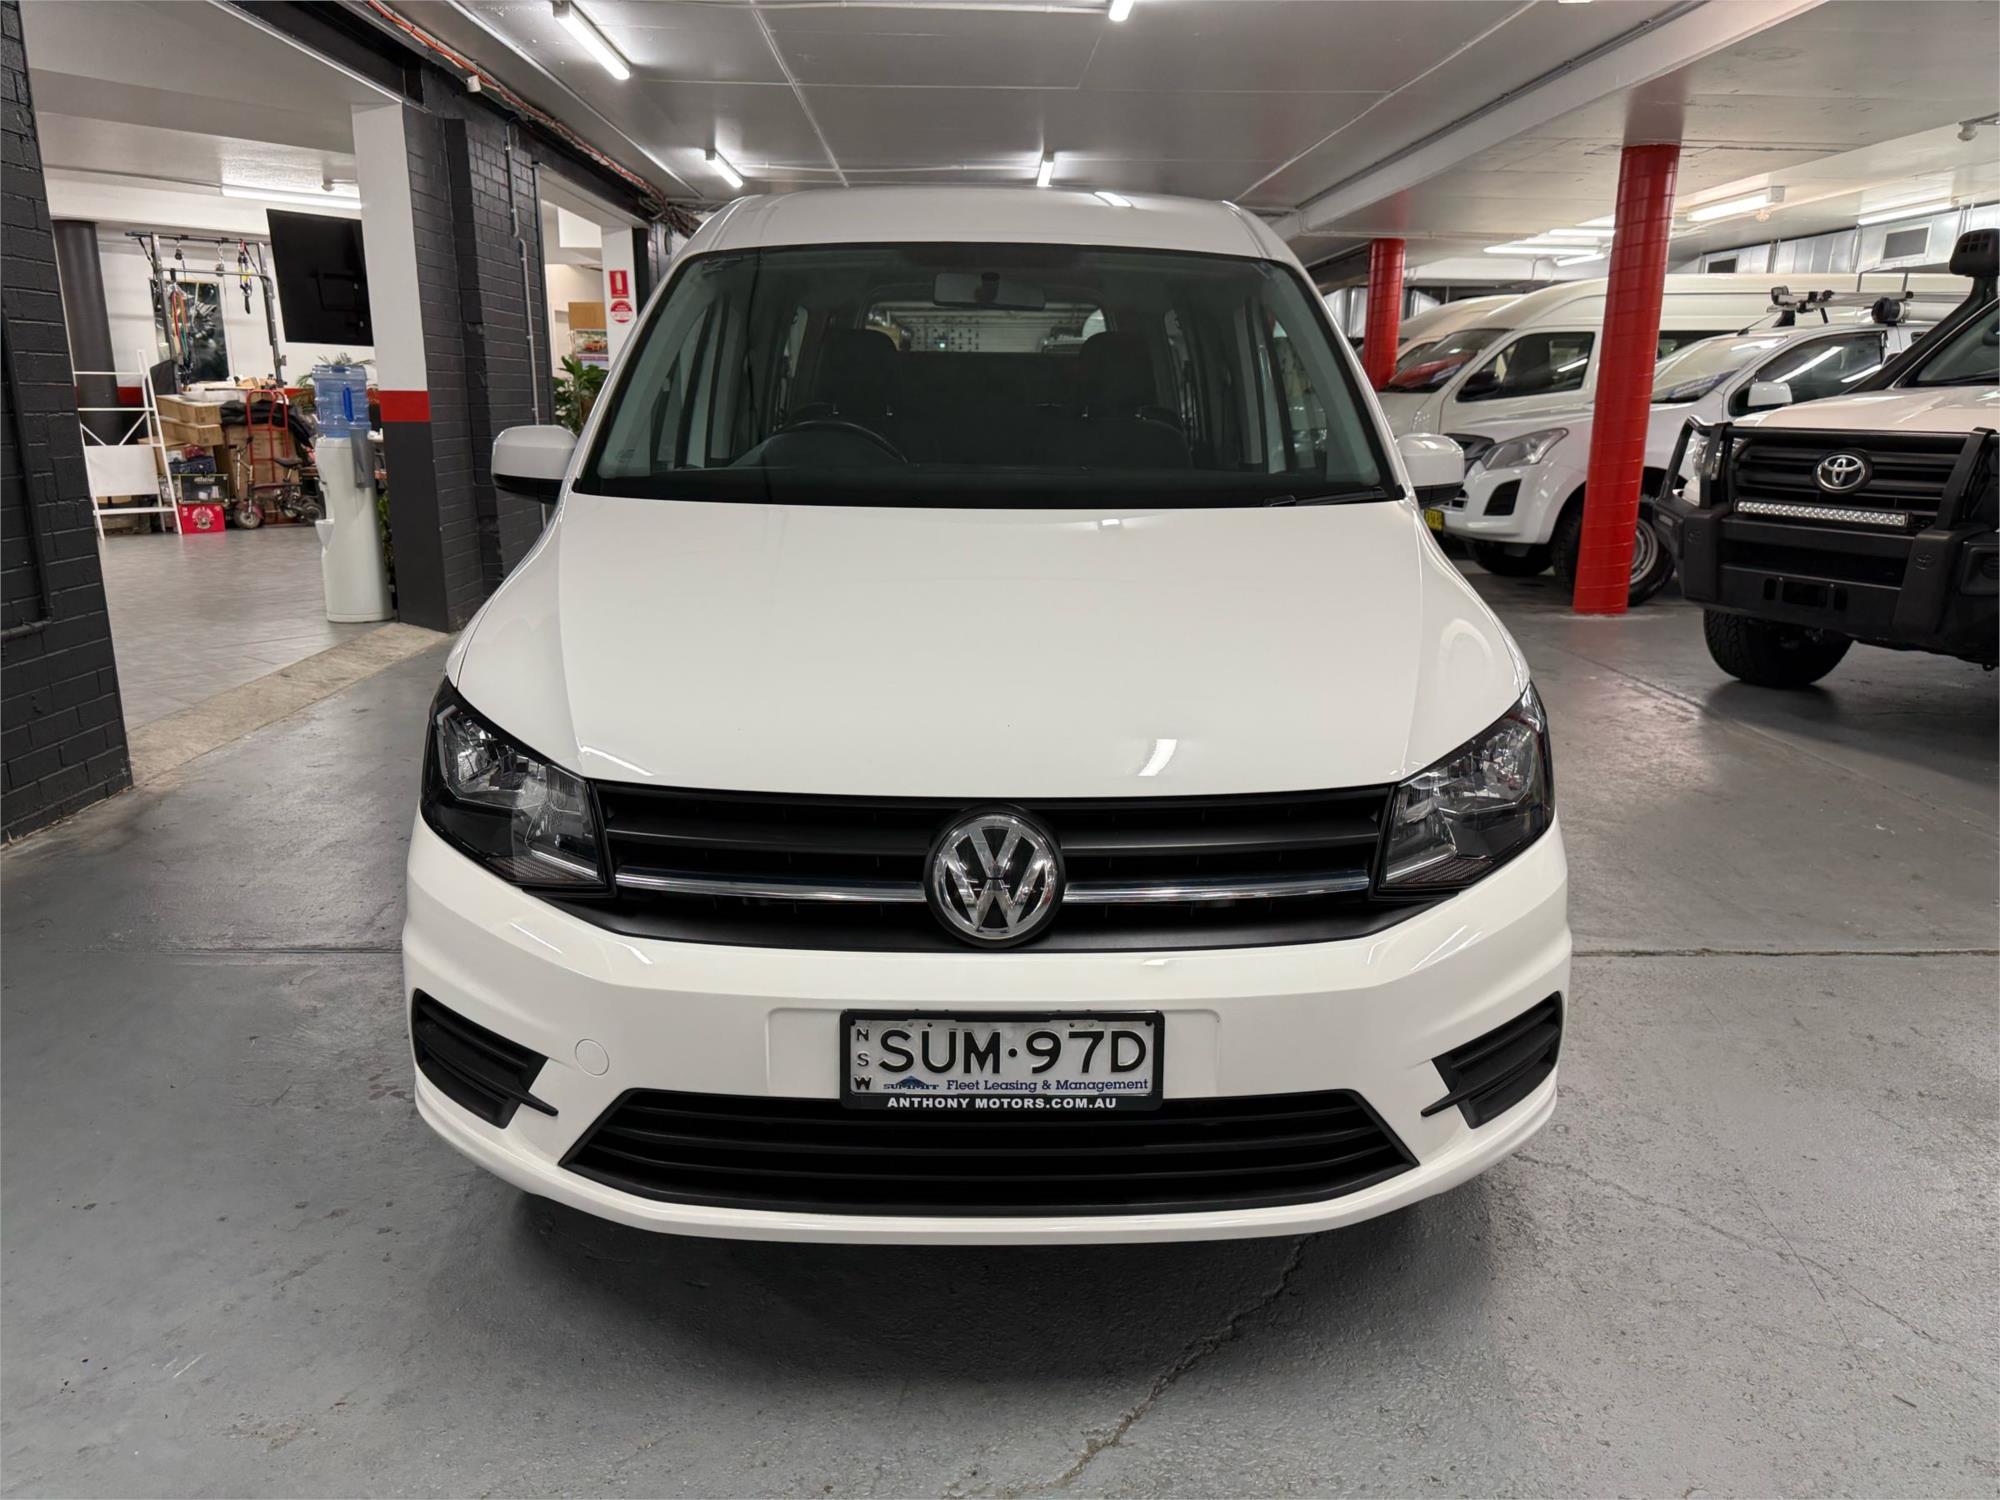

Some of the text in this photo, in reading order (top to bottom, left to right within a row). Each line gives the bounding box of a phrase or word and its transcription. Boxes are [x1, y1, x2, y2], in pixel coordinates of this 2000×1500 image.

[946, 1079, 980, 1090] Fleet
[984, 1079, 1037, 1093] Leasing
[1042, 1080, 1051, 1090] &
[1055, 1078, 1149, 1092] Management
[887, 1097, 1117, 1109] ANTHONY MOTORS.COM.AU
